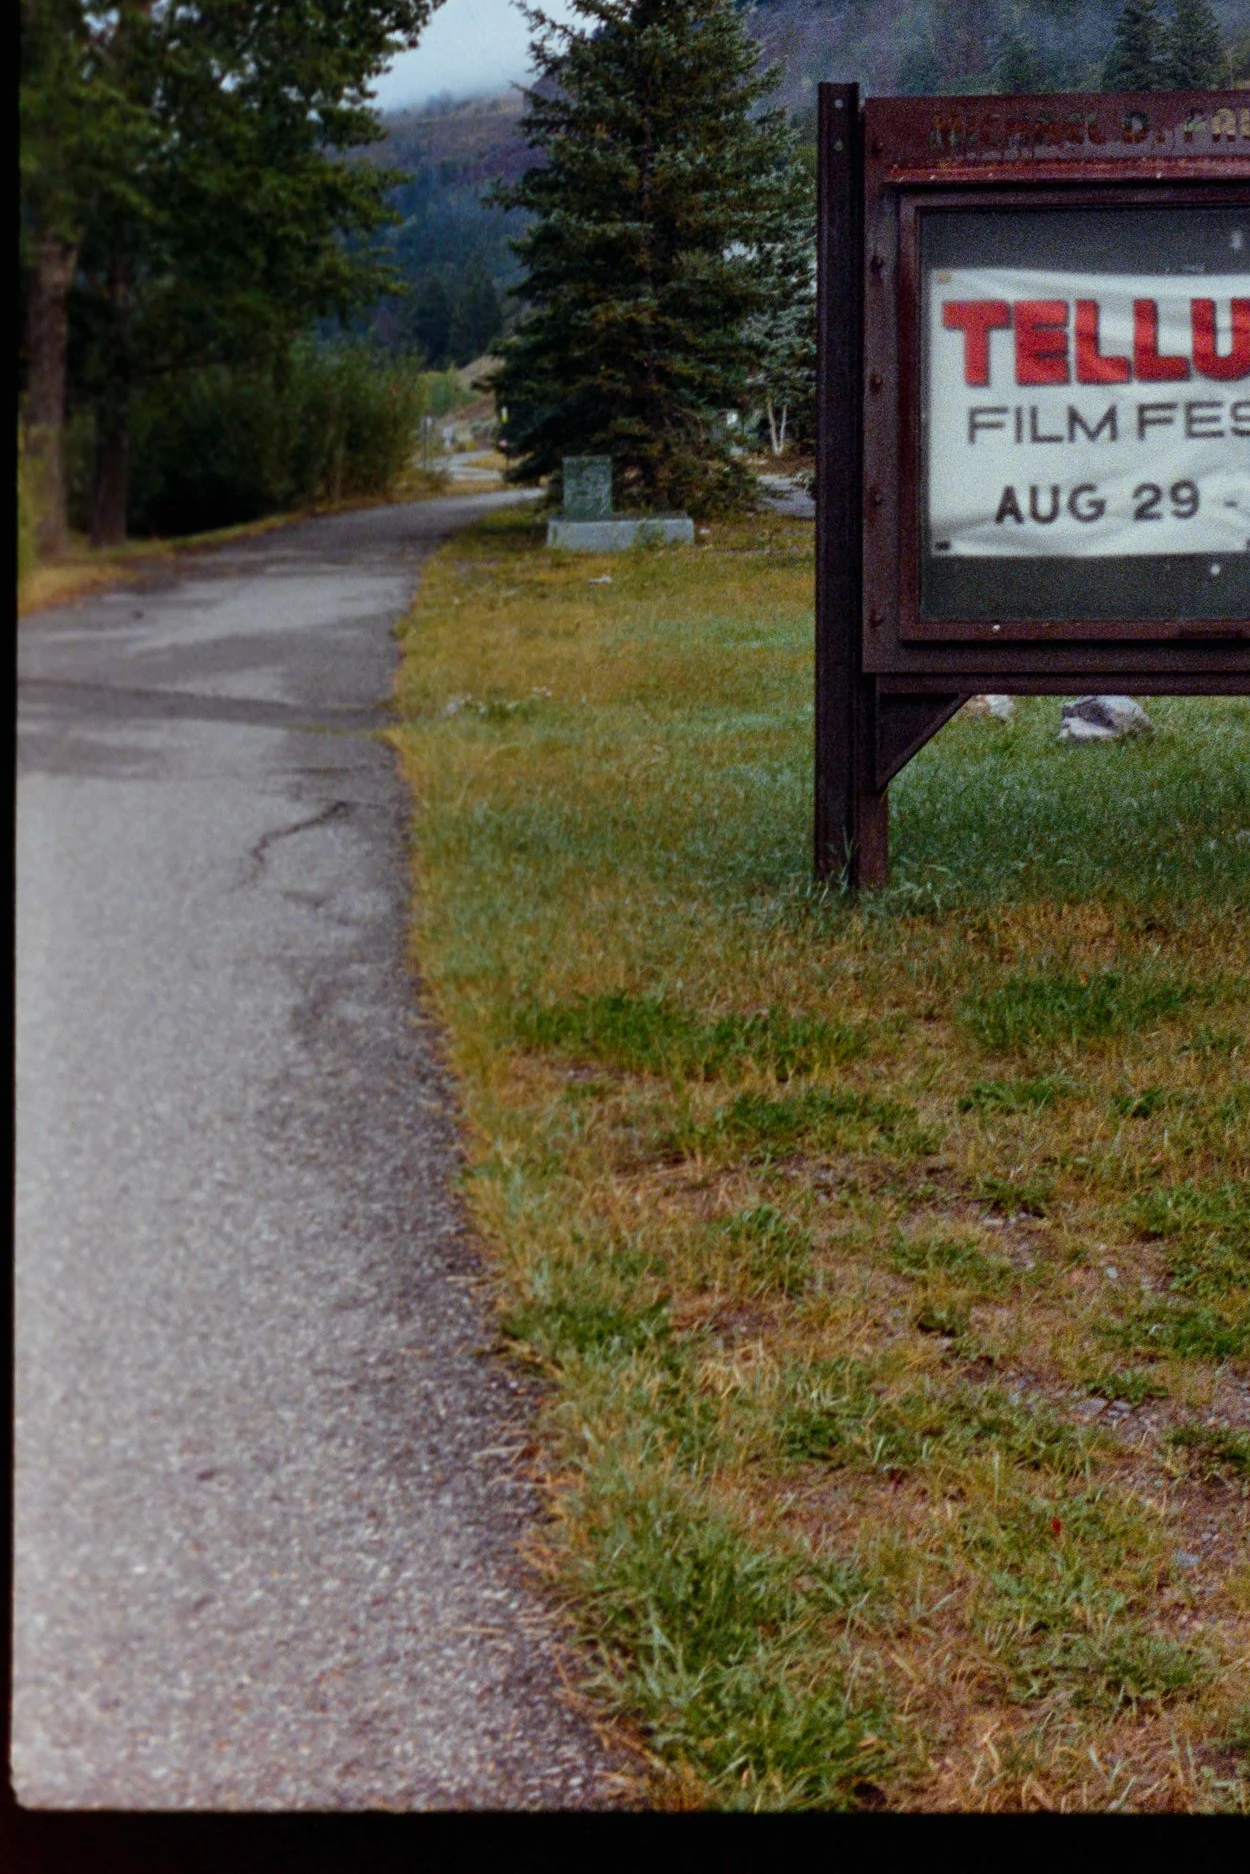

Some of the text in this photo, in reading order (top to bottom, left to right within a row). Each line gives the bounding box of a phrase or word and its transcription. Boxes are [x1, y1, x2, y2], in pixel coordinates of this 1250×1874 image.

[967, 403, 1120, 445] FILM
[995, 483, 1105, 526] AUG
[1131, 478, 1201, 522] 29
